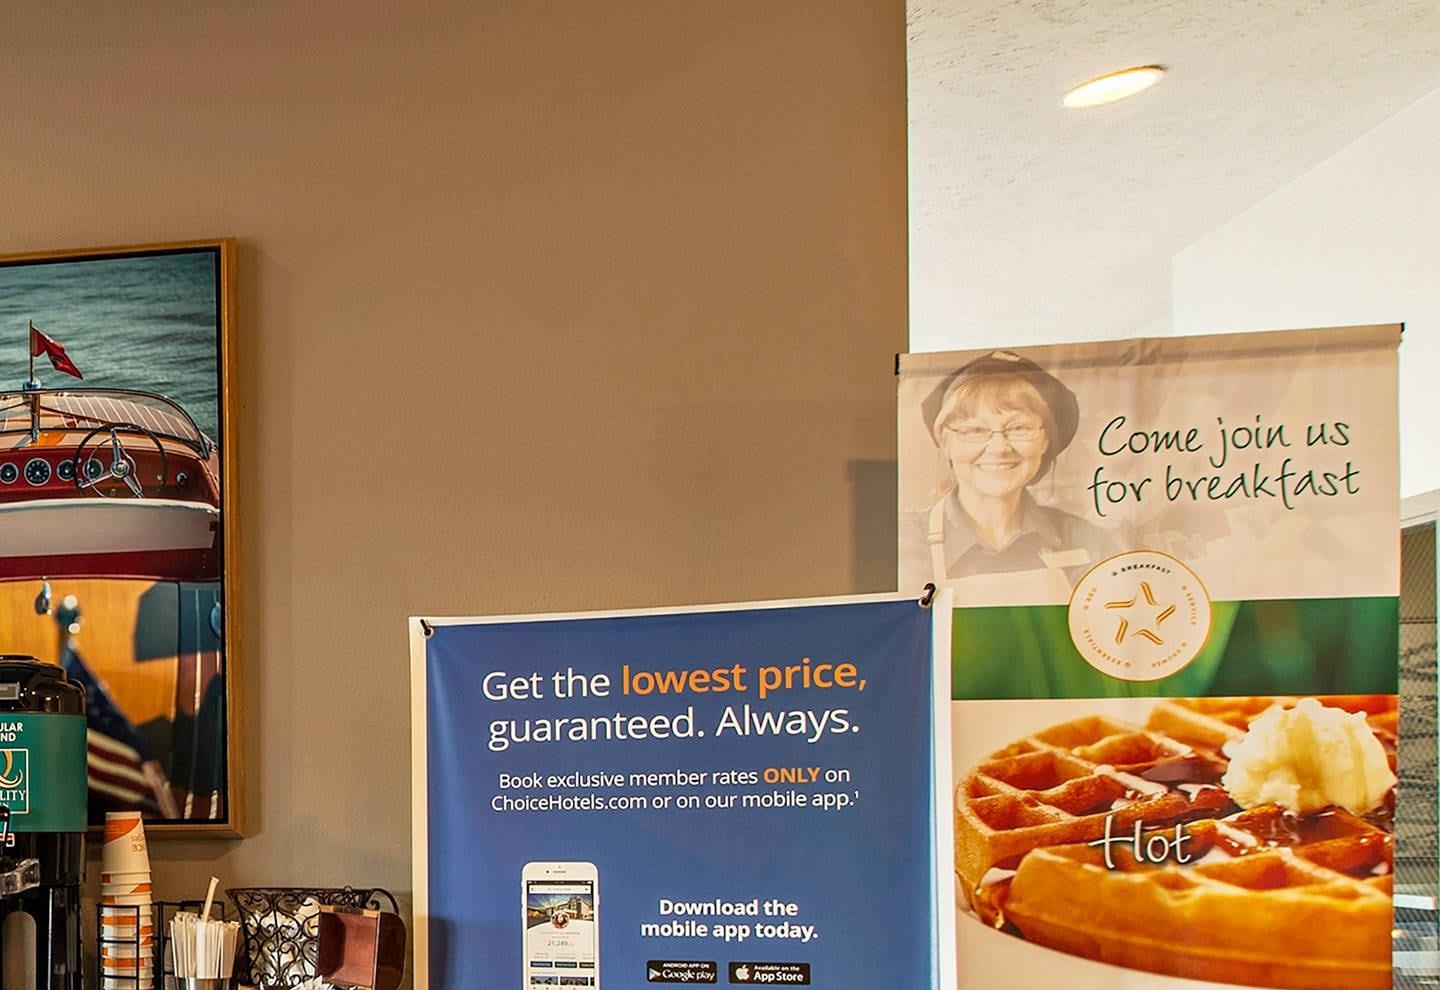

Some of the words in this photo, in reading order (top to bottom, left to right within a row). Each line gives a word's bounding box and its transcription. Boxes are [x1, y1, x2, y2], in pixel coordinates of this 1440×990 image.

[1098, 415, 1203, 457] Come
[1209, 414, 1291, 468] join
[1306, 418, 1351, 448] us
[1086, 466, 1153, 517] for
[1165, 457, 1362, 511] breakfast
[1121, 563, 1171, 575] BREAKFAST
[482, 671, 543, 700] Get
[551, 667, 610, 697] the
[622, 663, 746, 694] lowest
[759, 657, 865, 698] price,
[488, 706, 704, 751] guaranteed.
[715, 704, 859, 742] Always.
[499, 772, 542, 788] Book
[546, 771, 624, 787] exclusive
[629, 769, 707, 786] member
[712, 770, 758, 784] rates
[763, 767, 820, 783] ONLY
[825, 769, 849, 782] on
[491, 793, 646, 810] ChoiceHotels.com
[651, 796, 672, 808] or
[676, 795, 699, 808] on
[705, 795, 737, 807] our
[742, 790, 807, 807] mobile
[1088, 815, 1192, 870] Hot
[659, 898, 758, 915] Download
[763, 898, 798, 915] the
[641, 920, 708, 936] mobile
[712, 924, 750, 941] app
[754, 921, 818, 942] today.
[662, 969, 696, 982] Google
[696, 970, 715, 982] play
[753, 971, 776, 983] App
[776, 972, 804, 982] Store
